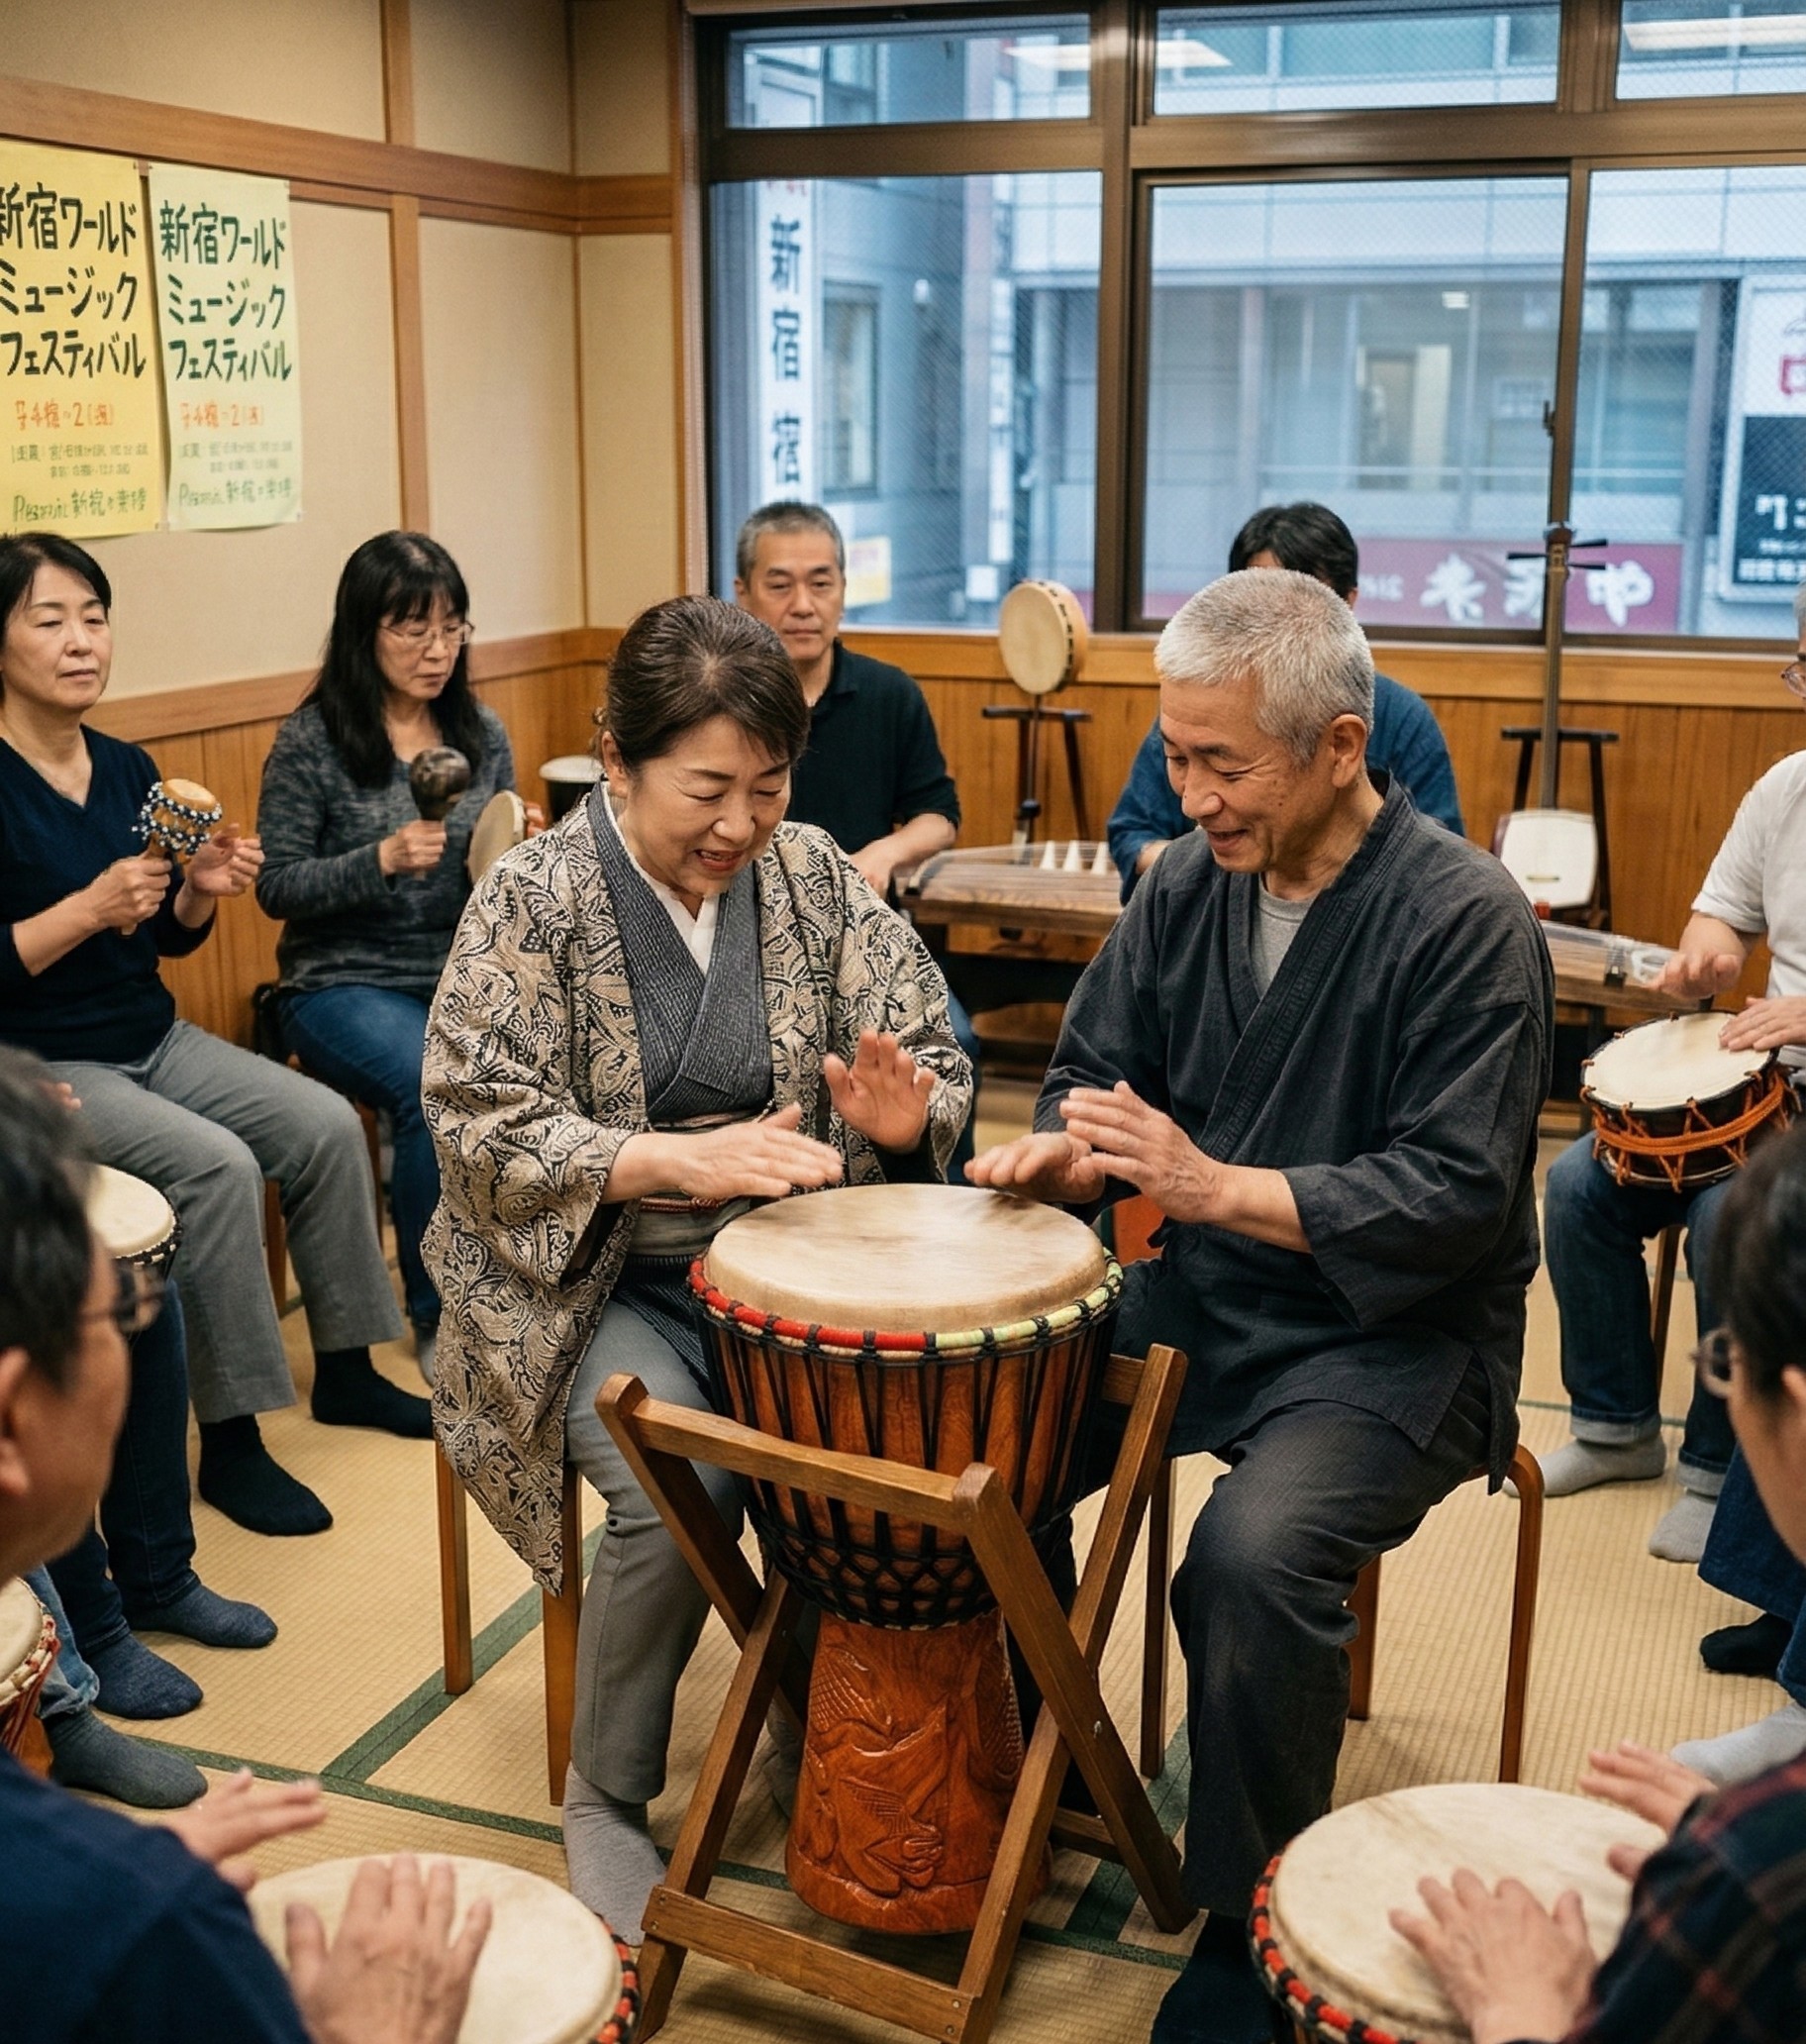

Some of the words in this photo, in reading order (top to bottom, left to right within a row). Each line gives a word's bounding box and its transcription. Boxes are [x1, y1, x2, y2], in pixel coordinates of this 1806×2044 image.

[0, 182, 137, 257] 新宿ワールド
[159, 200, 286, 269] 新宿ワールド
[0, 258, 138, 322] ミュージック
[167, 273, 285, 330] ミュージック
[0, 331, 147, 379] フェスティバル
[168, 338, 293, 383] フェスティバル
